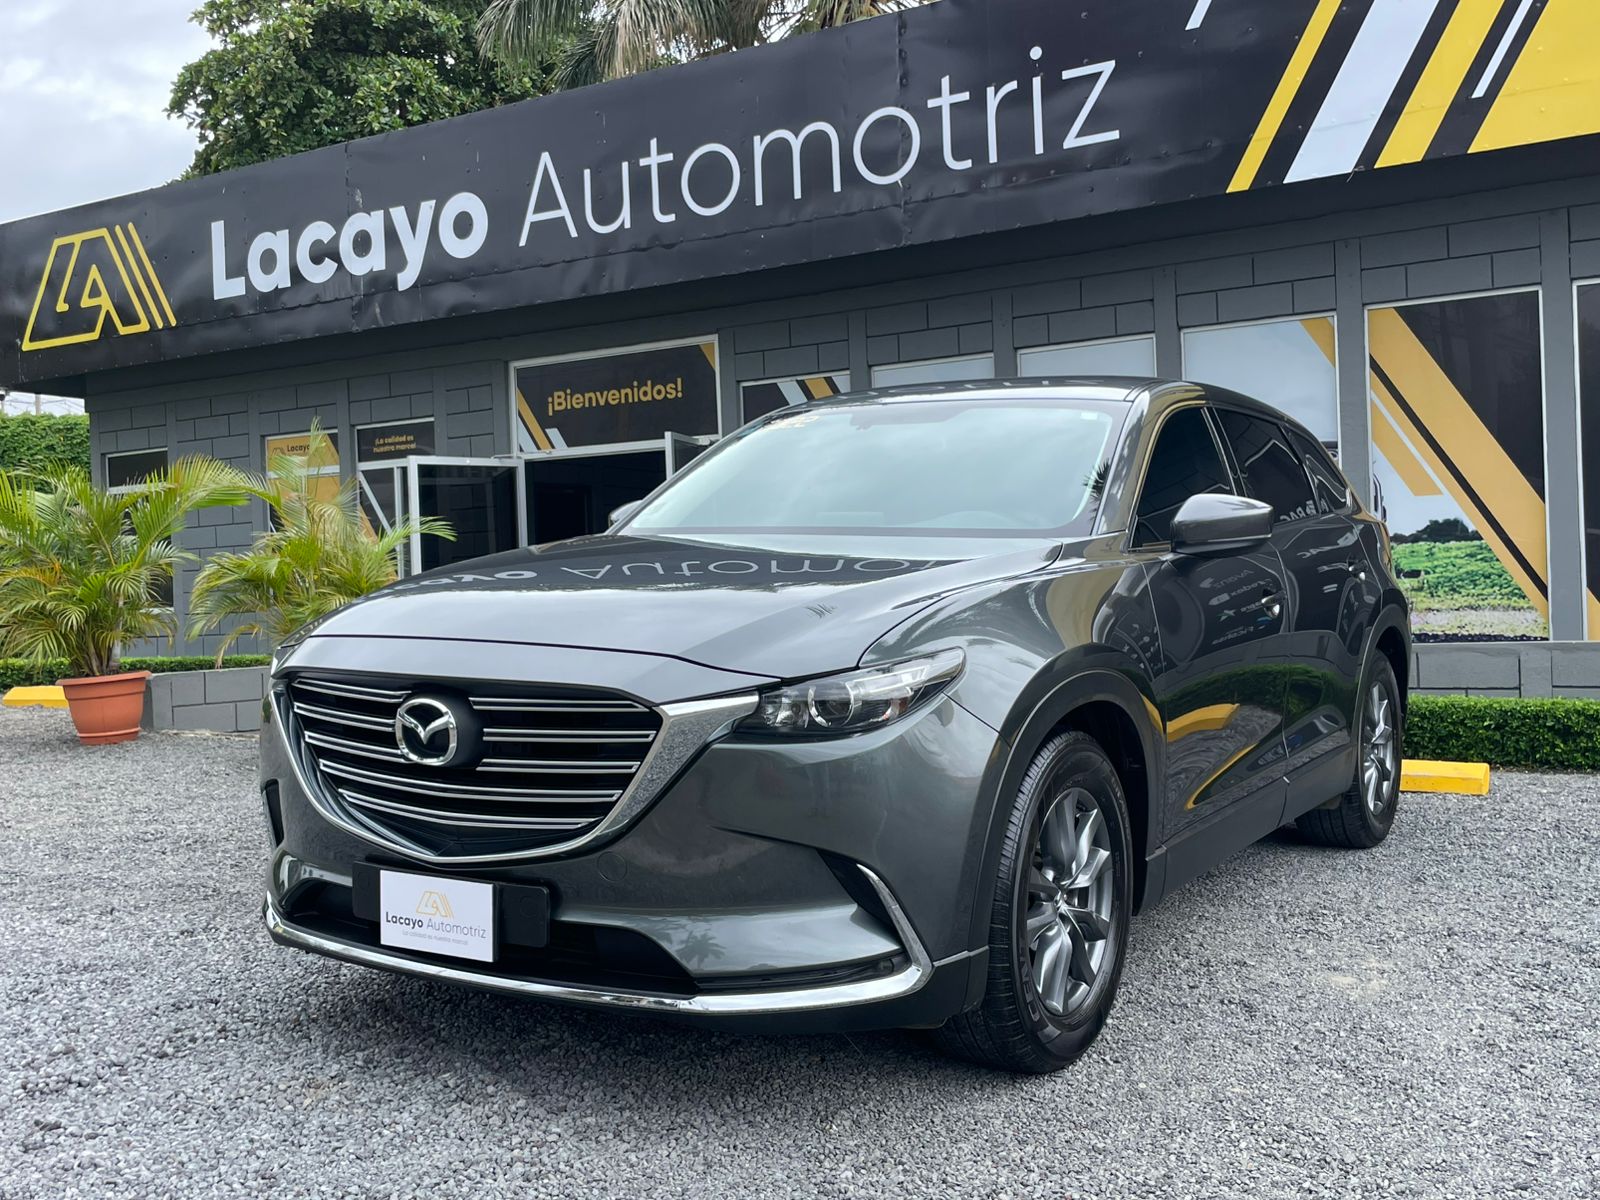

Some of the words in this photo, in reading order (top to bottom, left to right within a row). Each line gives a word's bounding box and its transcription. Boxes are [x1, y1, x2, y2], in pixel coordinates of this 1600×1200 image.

[211, 191, 489, 300] Lacayo
[518, 46, 1121, 248] Automotriz
[547, 377, 683, 417] ¡Bienvenidos!
[385, 911, 424, 930] Lacayo
[426, 918, 487, 939] Automotriz
